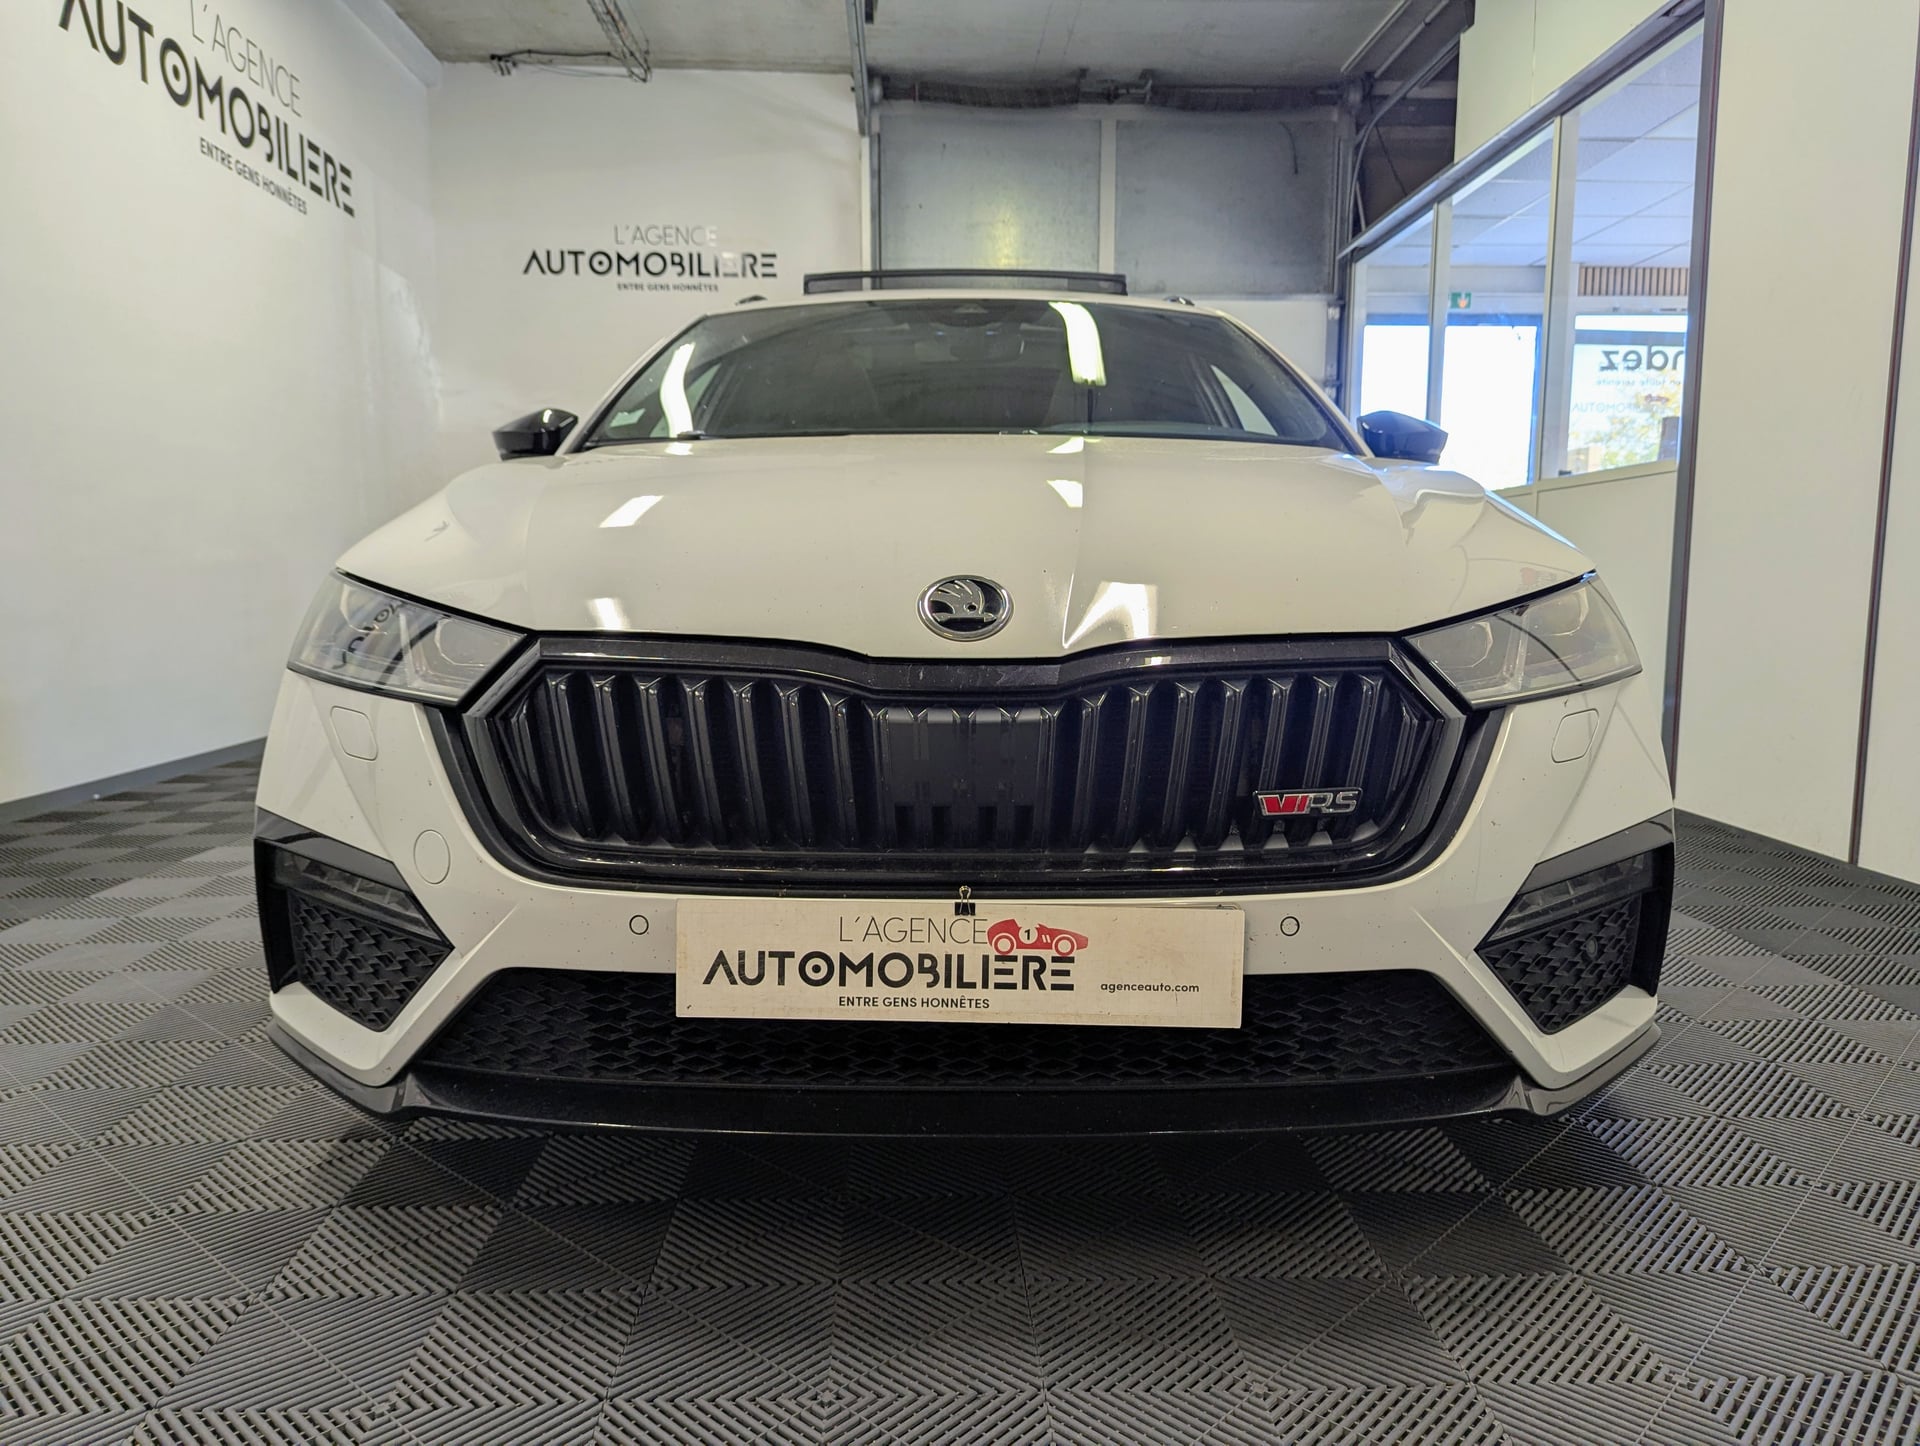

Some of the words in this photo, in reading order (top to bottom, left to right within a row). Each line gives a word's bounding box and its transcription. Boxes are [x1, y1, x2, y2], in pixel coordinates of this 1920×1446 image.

[200, 137, 233, 171] ENTRE
[235, 159, 260, 187] GENS
[523, 250, 778, 278] AUTOMOBILIERE
[617, 283, 644, 291] ENTRE
[647, 283, 670, 292] GENS
[840, 916, 988, 944] L'AGENCE
[1024, 929, 1032, 941] 1
[702, 950, 1075, 991] AUTOMOBILIERE
[1100, 982, 1200, 993] agenceauto.com
[839, 996, 879, 1007] ENTRE
[883, 997, 917, 1008] GENS
[921, 995, 990, 1009] HONNÊTES
